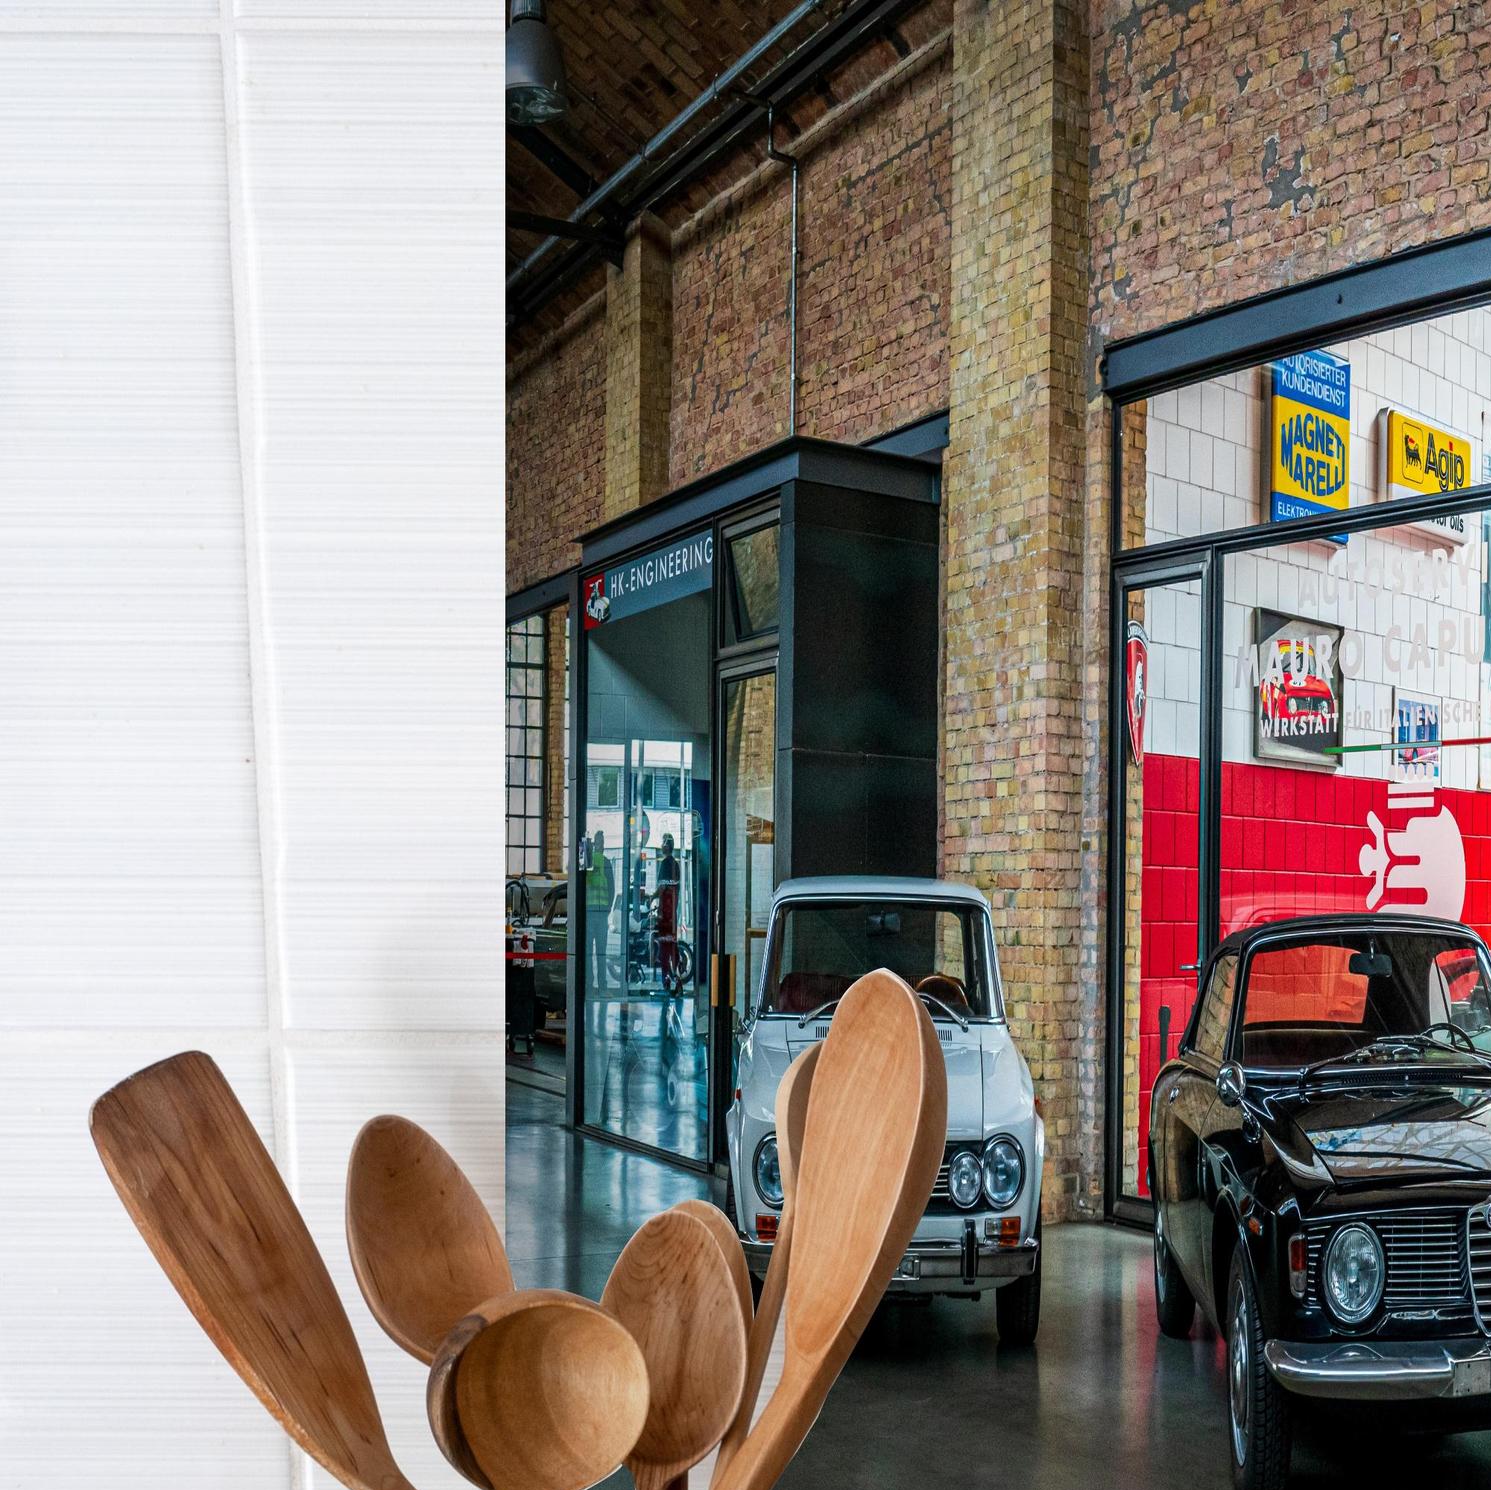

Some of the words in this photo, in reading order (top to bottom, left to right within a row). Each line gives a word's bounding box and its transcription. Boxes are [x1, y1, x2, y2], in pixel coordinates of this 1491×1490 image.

[1281, 368, 1346, 407] KUNDENDIENST
[1281, 452, 1346, 497] MARELLI
[1425, 432, 1465, 493] Agip
[611, 536, 713, 599] HK-ENGINEERING
[1235, 635, 1363, 689] MAURO
[1345, 706, 1372, 731] FÜR
